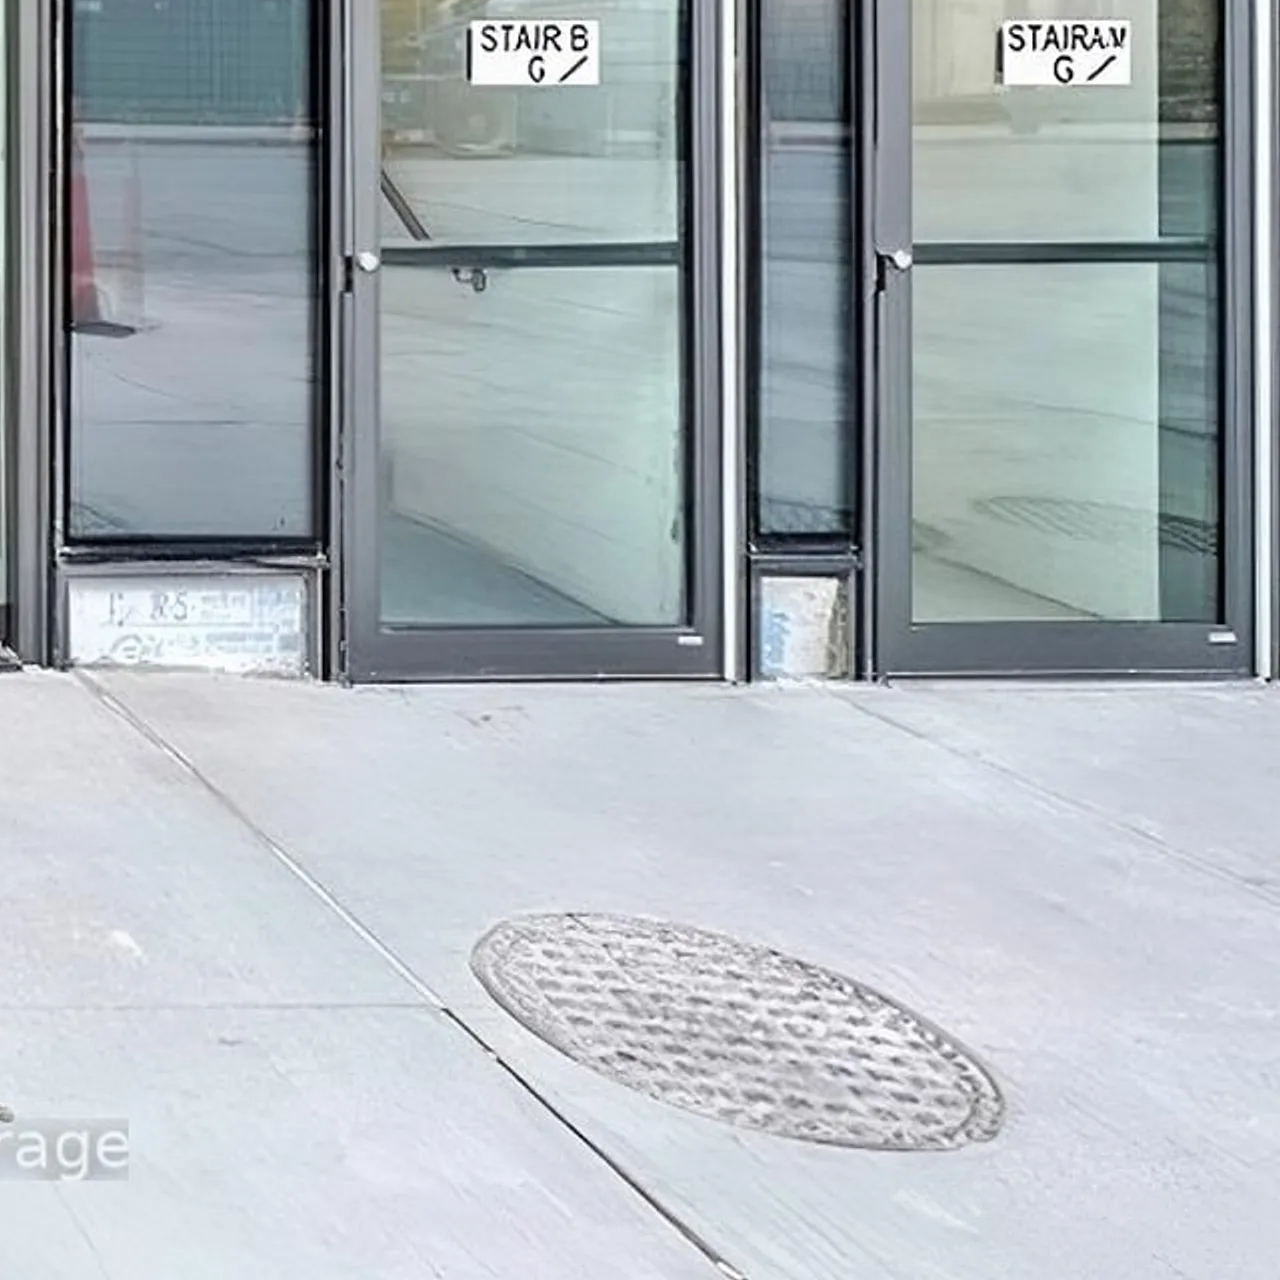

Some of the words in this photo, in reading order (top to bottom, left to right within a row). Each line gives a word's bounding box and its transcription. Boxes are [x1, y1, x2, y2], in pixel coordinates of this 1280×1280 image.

[481, 24, 562, 51] STAIR
[571, 24, 588, 51] B
[528, 55, 545, 83] G
[1053, 55, 1073, 83] G
